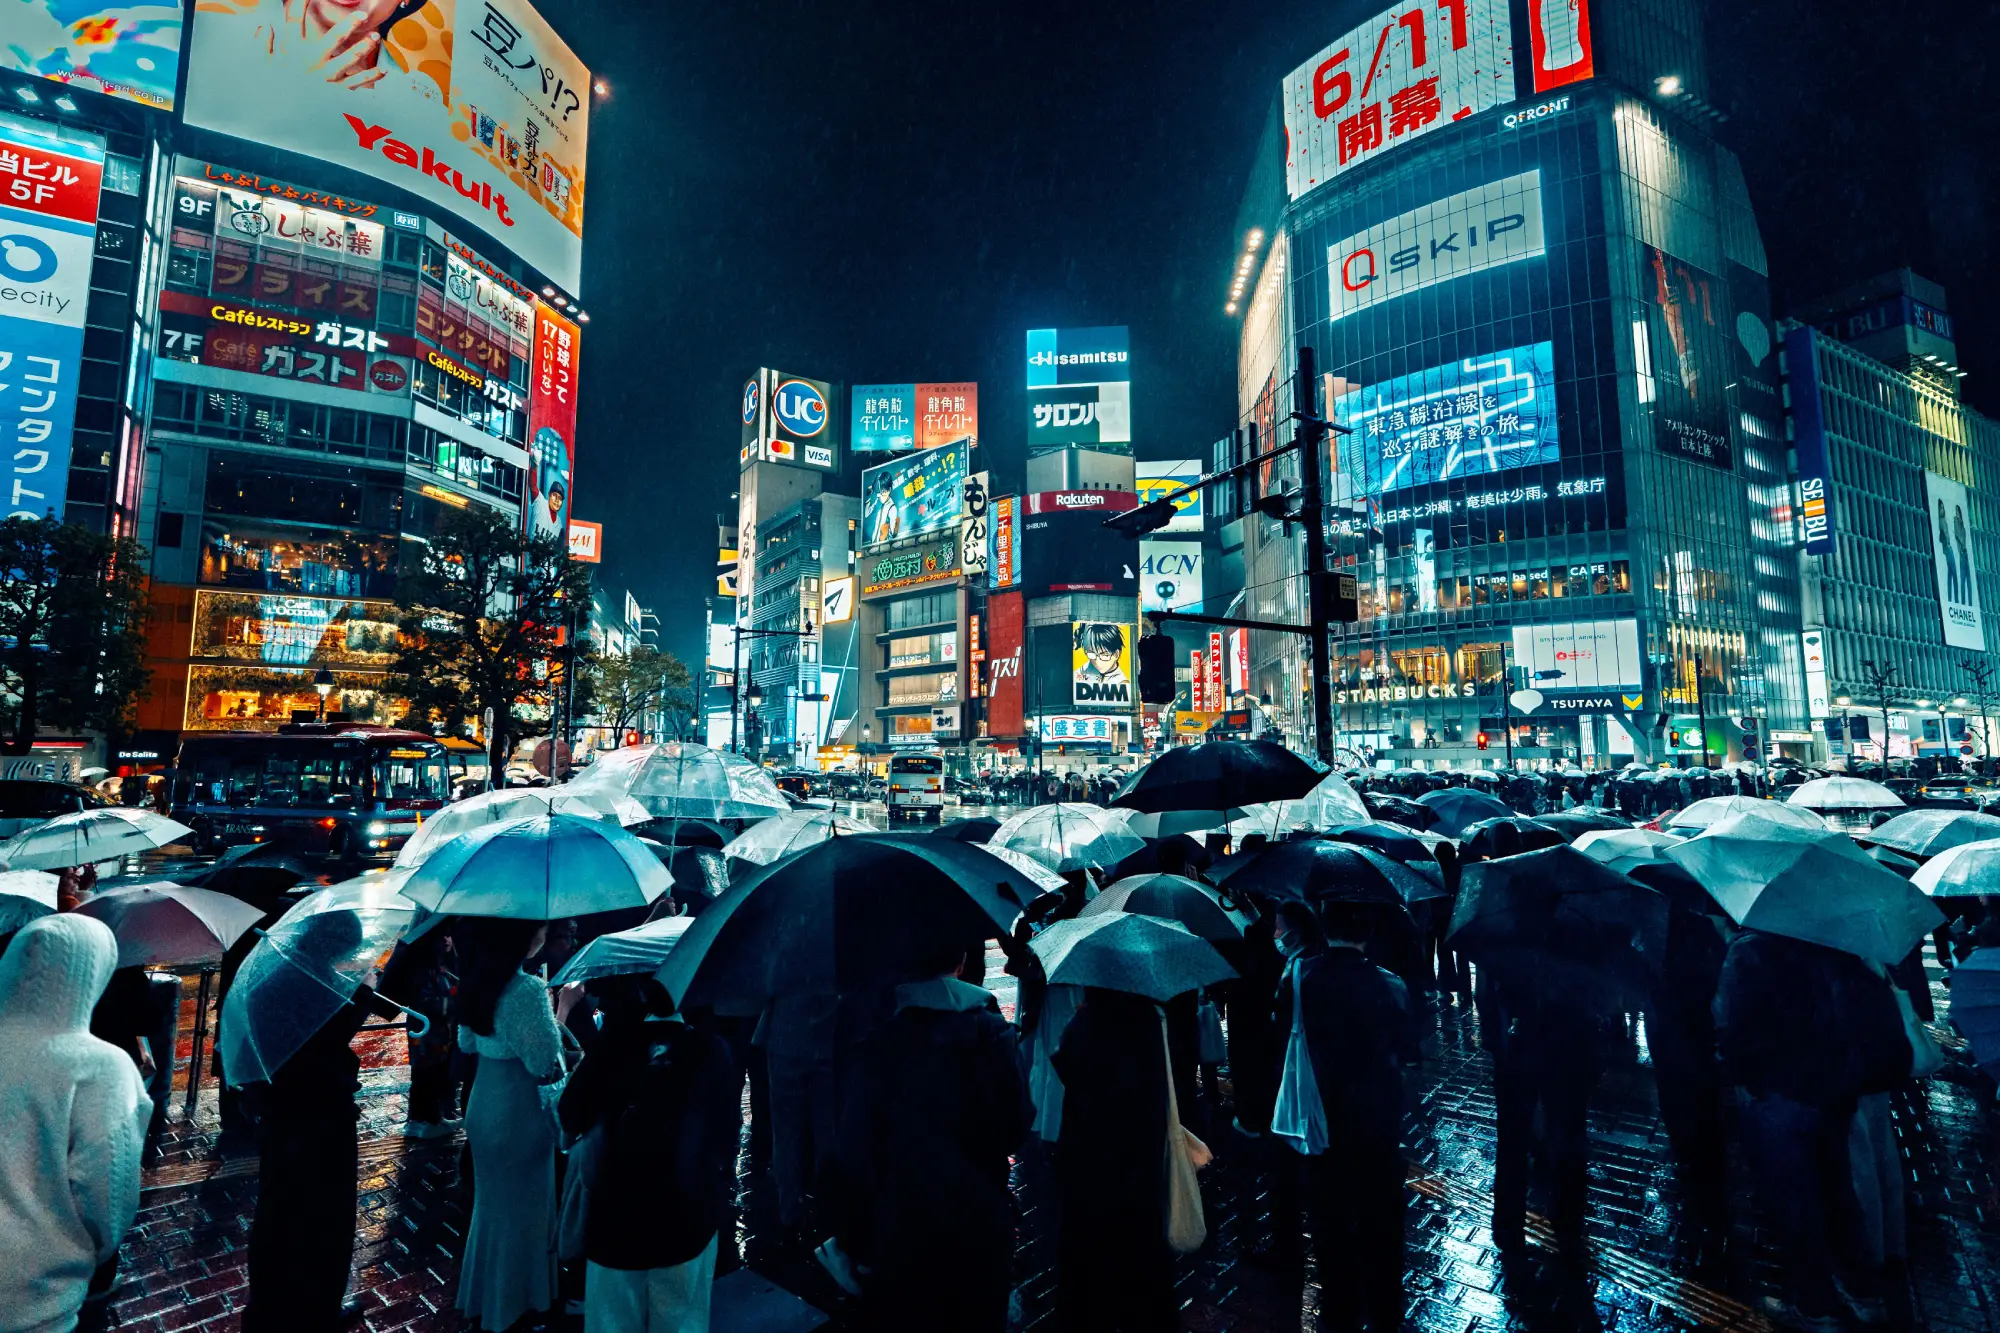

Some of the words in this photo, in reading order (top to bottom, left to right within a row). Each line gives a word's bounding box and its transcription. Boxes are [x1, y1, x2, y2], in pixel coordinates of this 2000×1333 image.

[1338, 76, 1441, 166] 開幕
[1504, 97, 1569, 128] QFRONT
[342, 112, 515, 228] Yakult
[10, 179, 56, 205] 5F
[205, 163, 379, 218] しゃぶしゃぶバイキング
[179, 196, 212, 216] 9F
[277, 214, 372, 256] しゃぶ葉
[443, 231, 535, 302] しゃぶしゃぶバイキング
[1341, 248, 1379, 292] Q
[1390, 213, 1525, 274] SKIP
[0, 287, 70, 314] ecity
[216, 263, 370, 311] プライス
[476, 284, 529, 334] しゃぶ葉
[163, 330, 203, 351] 7F
[314, 321, 390, 352] ガスト
[417, 306, 506, 369] コンタクト
[260, 344, 357, 384] ガスト
[555, 329, 572, 404] 野球って
[1028, 351, 1128, 367] Hisamitsu
[374, 370, 404, 384] ガスト
[484, 379, 523, 411] ガスト
[744, 389, 757, 416] UC
[780, 391, 824, 424] UC
[865, 397, 902, 414] 龍角散
[928, 396, 966, 413] 龍角散
[1366, 391, 1497, 437] 東急線沿線を
[1381, 413, 1520, 460] 巡る謎解きの旅
[807, 449, 831, 463] VISA
[1056, 493, 1104, 508] Rakuten
[1556, 477, 1606, 497] 気象庁
[963, 476, 988, 570] もんじゃ
[1801, 477, 1828, 543] SEIBU
[1025, 521, 1048, 531] SHIBUYA
[997, 502, 1009, 583] 三千里薬品
[894, 559, 922, 578] 西村
[1139, 554, 1200, 575] ACN
[1474, 575, 1507, 586] Time
[1512, 569, 1548, 581] based
[1570, 564, 1605, 576] CAFE
[1948, 606, 1976, 623] CHANEL
[1211, 638, 1221, 678] カラオケ
[1075, 682, 1129, 702] DMM
[1193, 682, 1201, 712] カラオ
[1337, 682, 1476, 704] STARBUCKS
[1551, 698, 1614, 709] TSUTAYA
